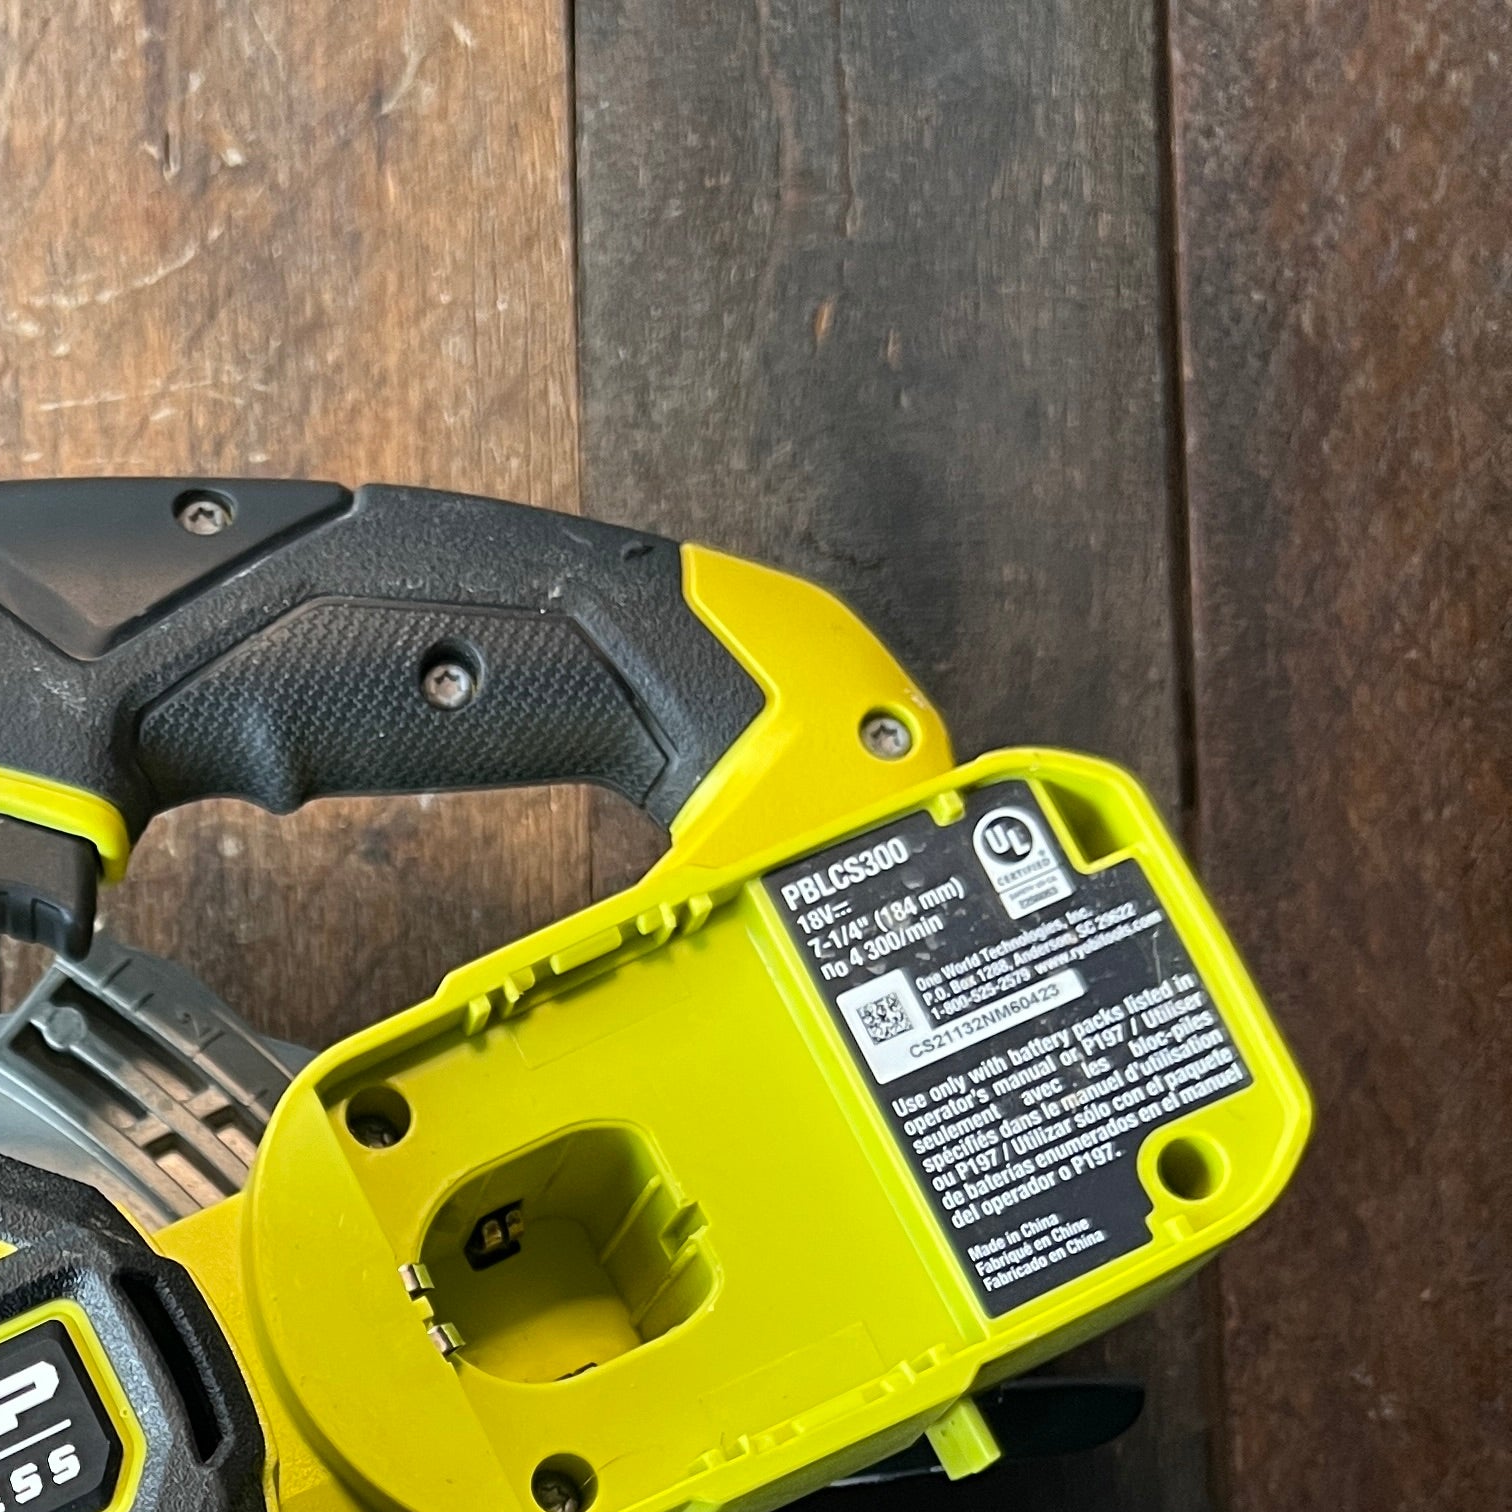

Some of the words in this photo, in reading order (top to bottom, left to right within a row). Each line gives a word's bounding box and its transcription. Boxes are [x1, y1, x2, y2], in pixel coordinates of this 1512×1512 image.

[779, 834, 911, 912] PBLCS300
[982, 815, 1032, 865] UL
[805, 915, 874, 960] 7-1/4"
[870, 894, 921, 934] (184
[915, 874, 967, 915] mm)
[845, 946, 865, 969] 4
[861, 910, 944, 961] 300/min
[913, 968, 943, 992] One
[939, 951, 982, 980] World
[1063, 901, 1094, 926] Inc.
[907, 981, 1061, 1059] CS21132NM60423
[921, 983, 951, 1007] P.O.
[948, 971, 977, 995] Box
[929, 965, 1033, 1021] 1-800-525-2579
[890, 1088, 928, 1118] Use
[925, 1071, 969, 1106] only
[965, 1053, 1008, 1085] with
[1005, 1024, 1074, 1071] battery
[1069, 1001, 1127, 1041] packs
[1121, 978, 1174, 1015] listed
[1170, 968, 1196, 994] in
[900, 1085, 992, 1139] operator's
[989, 1054, 1058, 1097] manual
[1057, 1046, 1082, 1068] or
[1080, 1023, 1128, 1057] P197
[1125, 1016, 1141, 1036] /
[1139, 987, 1206, 1030] Utiliser
[910, 1102, 1002, 1155] seulement
[1018, 1076, 1064, 1107] avec
[1079, 1052, 1112, 1080] les
[1126, 1006, 1216, 1061] bloc-piles
[919, 1125, 1001, 1176] spécifiés
[995, 1105, 1044, 1140] dans
[1039, 1097, 1061, 1120] le
[1057, 1068, 1126, 1112] manuel
[1120, 1024, 1225, 1084] d'utilisation
[930, 1170, 957, 1193] ou
[953, 1147, 1002, 1181] P197
[997, 1141, 1013, 1162] /
[1009, 1113, 1075, 1156] Utilizar
[1070, 1097, 1112, 1130] sólo
[1109, 1085, 1147, 1113] con
[1142, 1073, 1165, 1097] el
[1161, 1043, 1236, 1091] paquete
[938, 1186, 966, 1211] de
[962, 1154, 1037, 1201] baterías
[1031, 1108, 1140, 1170] enumerados
[1136, 1100, 1163, 1124] en
[1158, 1089, 1181, 1113] el
[1176, 1061, 1245, 1105] manuel
[948, 1202, 981, 1230] del
[977, 1167, 1060, 1219] operador
[1055, 1163, 1073, 1182] o
[1069, 1138, 1123, 1175] P197.
[966, 1233, 1007, 1262] Made
[1003, 1226, 1022, 1245] in
[1018, 1209, 1060, 1239] China
[974, 1240, 1035, 1279] Fabriqué
[1031, 1234, 1053, 1252] en
[1049, 1214, 1091, 1243] Chine
[981, 1252, 1049, 1293] Fabricado
[1046, 1246, 1067, 1264] en
[1063, 1226, 1107, 1256] China
